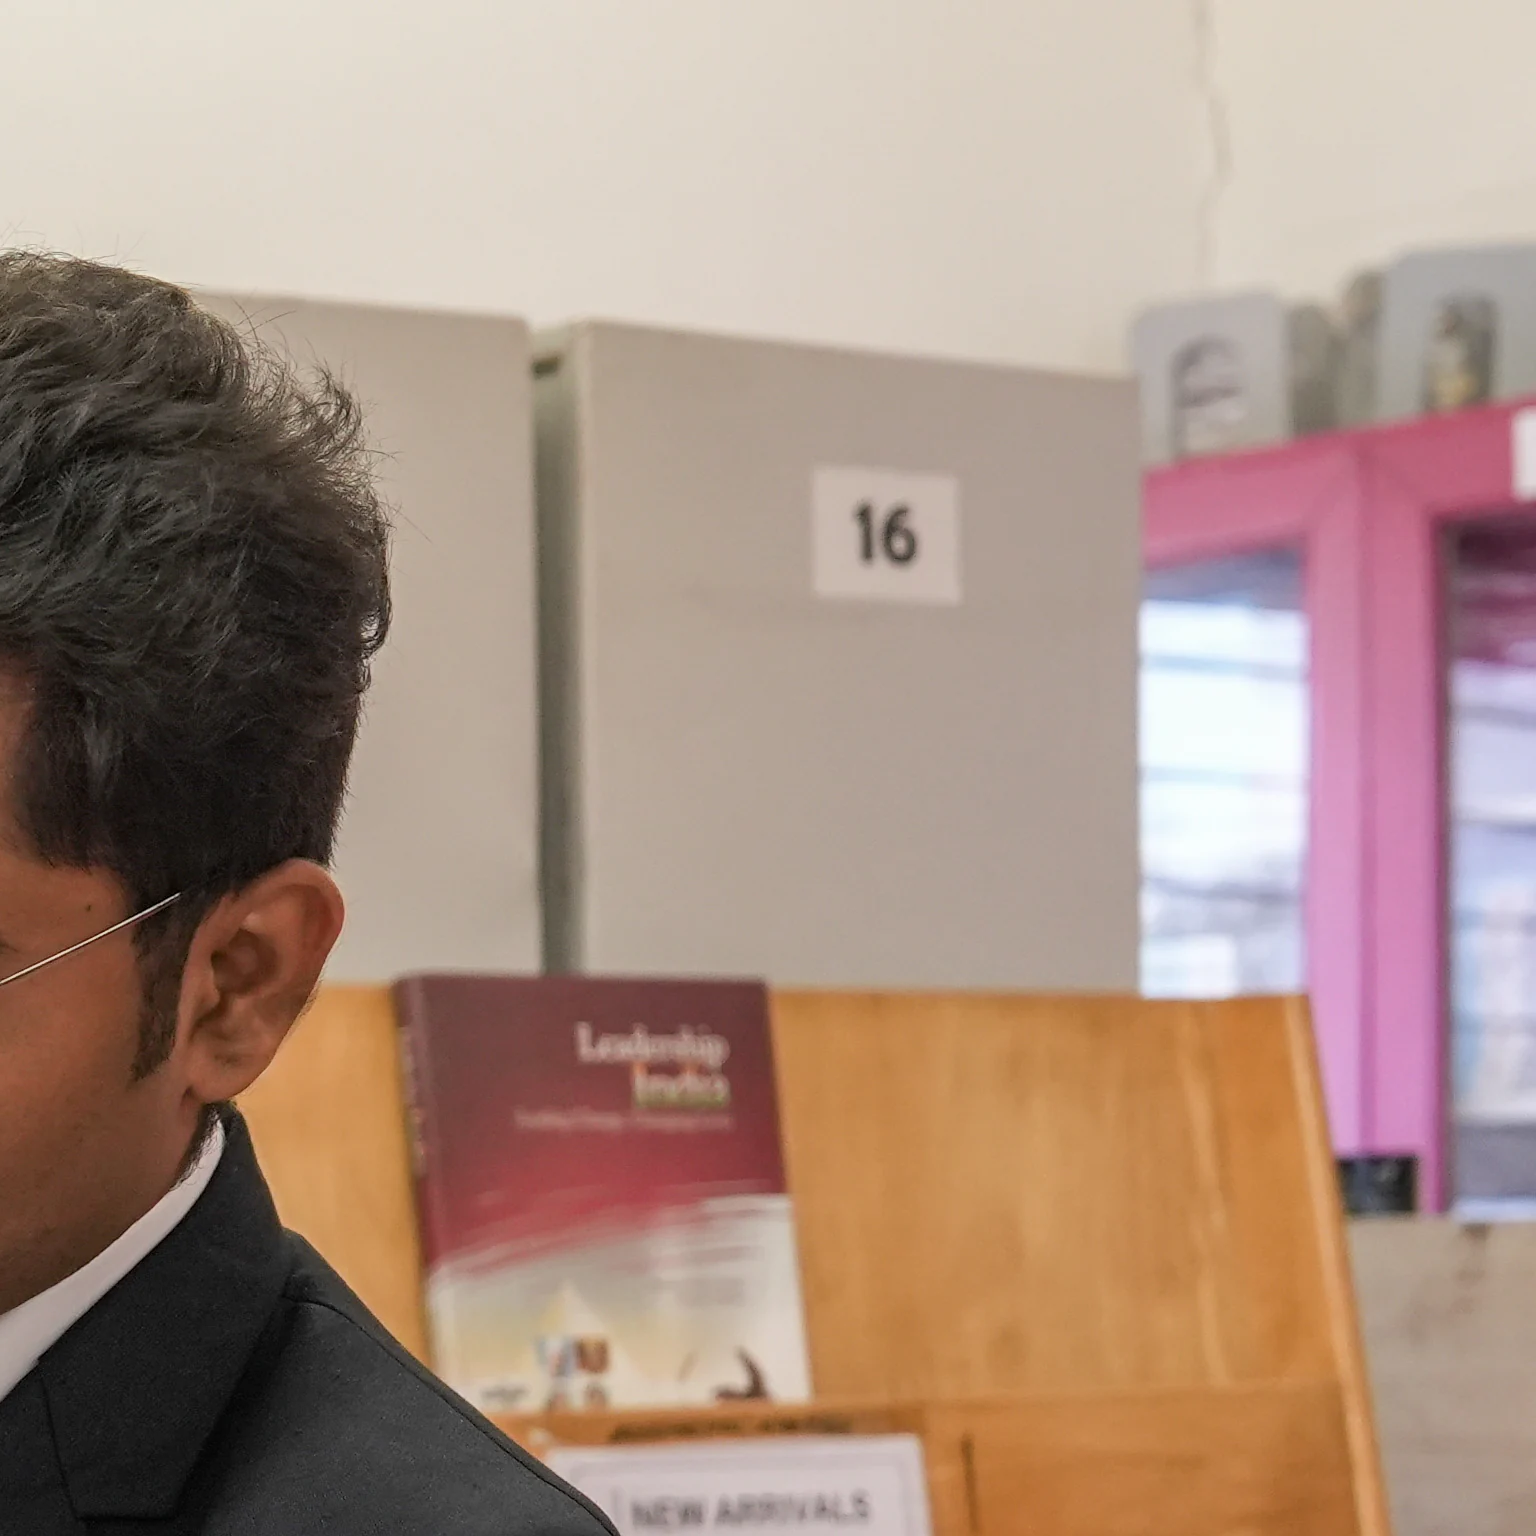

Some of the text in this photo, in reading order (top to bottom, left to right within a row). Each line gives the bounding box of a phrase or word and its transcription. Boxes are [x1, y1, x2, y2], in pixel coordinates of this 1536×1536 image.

[851, 499, 918, 568] 16
[630, 1488, 872, 1533] NEW ARRIVALS
